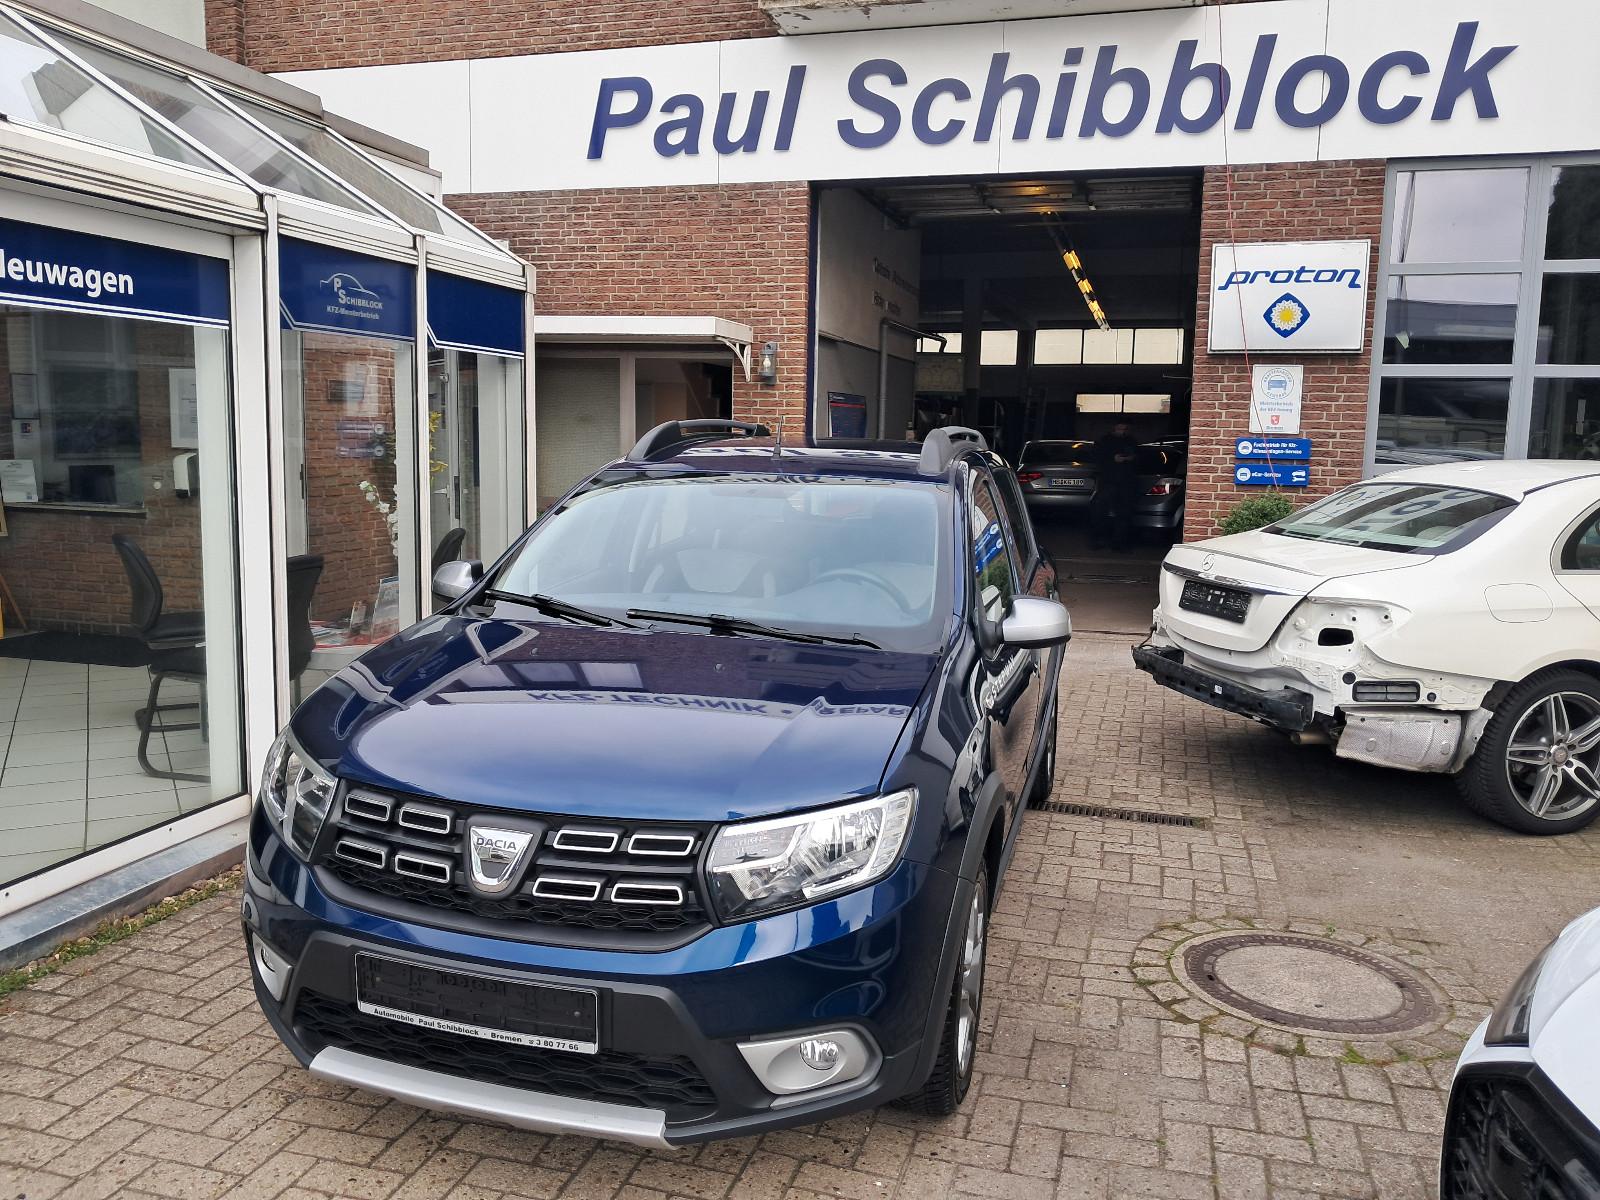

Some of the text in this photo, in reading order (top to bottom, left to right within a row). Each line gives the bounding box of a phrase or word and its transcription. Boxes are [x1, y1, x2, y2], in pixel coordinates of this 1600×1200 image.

[587, 21, 1519, 159] Paul Schibblock
[1217, 265, 1362, 291] proton
[991, 654, 1015, 699] STEPWAY
[476, 837, 517, 850] DACIA
[374, 1008, 415, 1023] Automobile
[418, 1012, 435, 1028] Paul
[436, 1021, 479, 1036] Schibblock
[490, 1032, 522, 1043] Bremen
[543, 1039, 554, 1048] 80
[556, 1042, 566, 1050] 77
